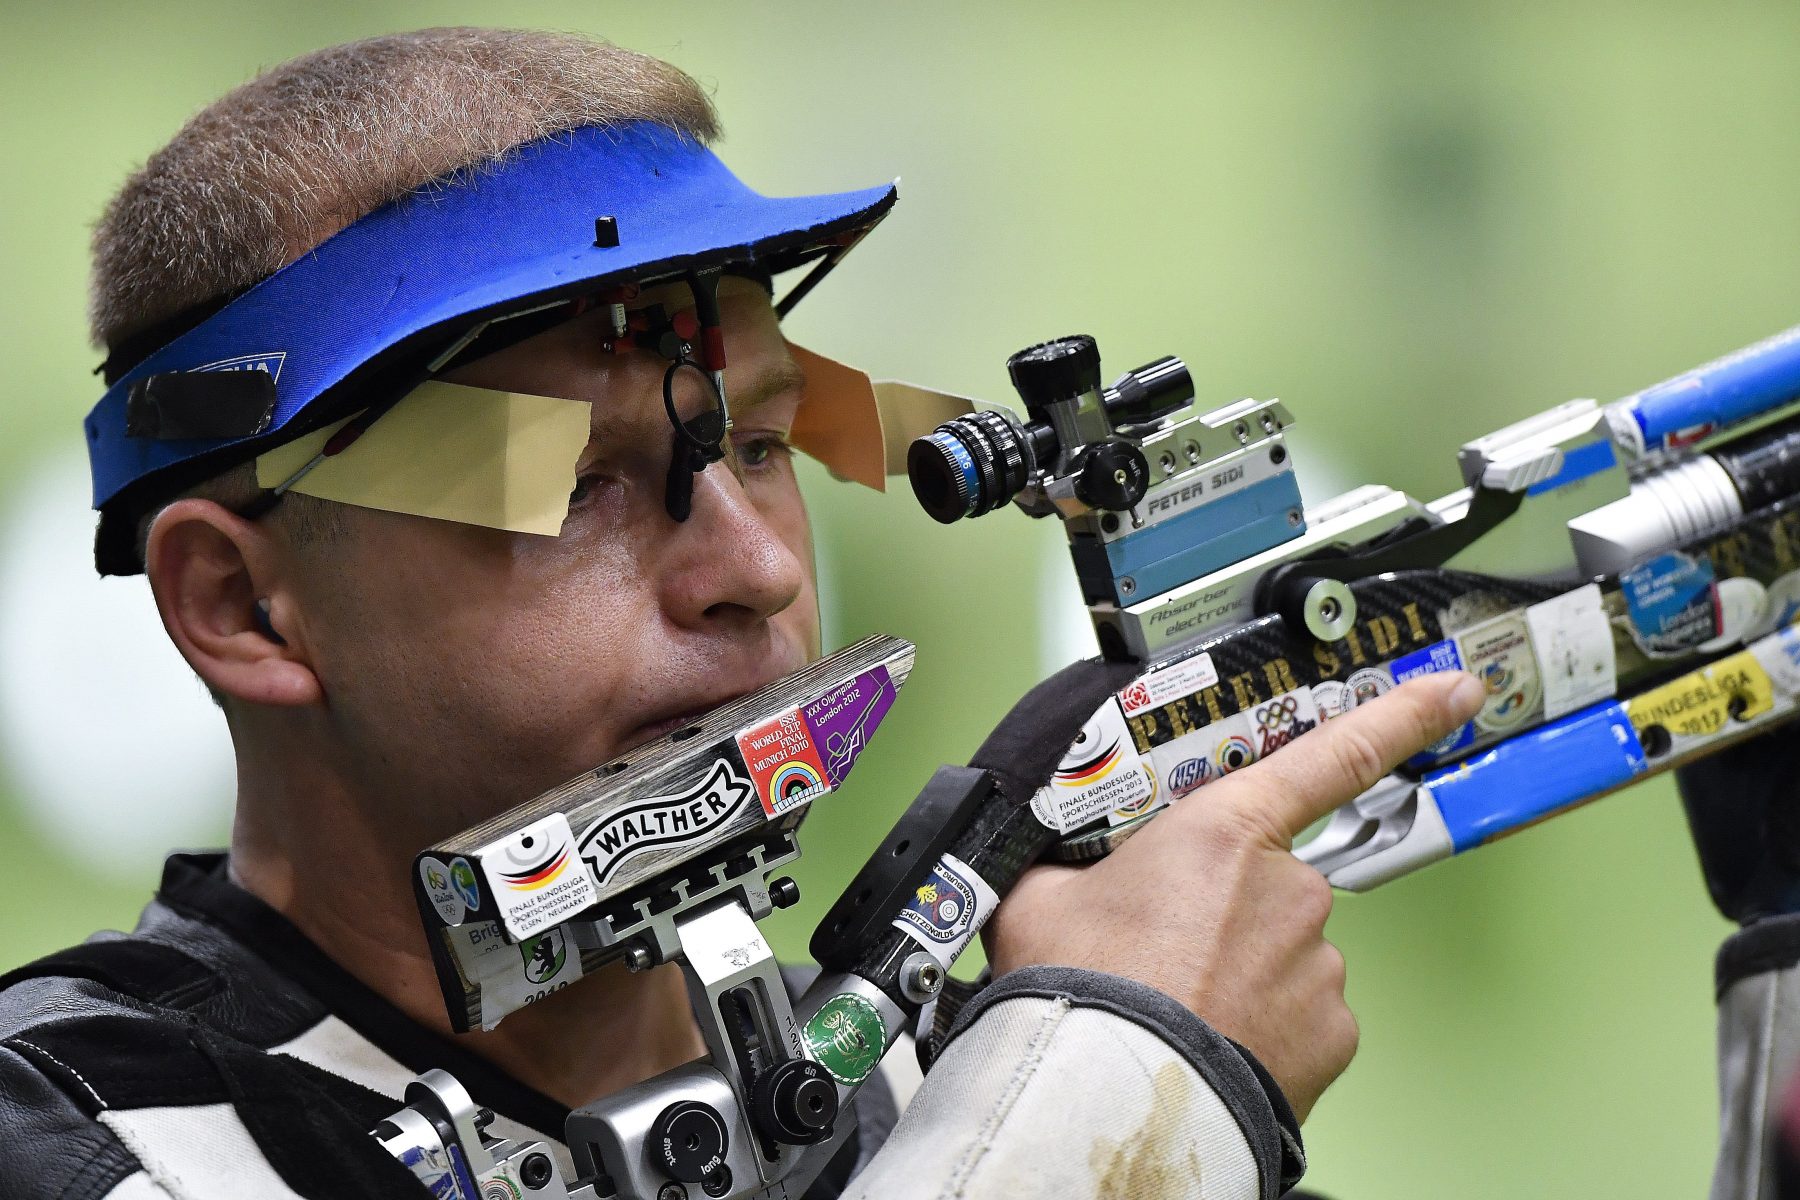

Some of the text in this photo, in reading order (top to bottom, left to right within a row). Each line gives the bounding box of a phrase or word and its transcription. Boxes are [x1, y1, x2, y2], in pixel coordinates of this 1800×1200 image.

[1148, 481, 1203, 515] PETER
[1150, 584, 1234, 625] Absorber
[1128, 657, 1298, 754] PETER
[1313, 602, 1428, 680] SIDI
[806, 678, 857, 718] XXX Olympiad
[815, 689, 860, 727] London 2012
[751, 720, 802, 751] WORLD CUP
[778, 711, 798, 728] ISSF
[753, 739, 809, 773] MUNICH 2010
[780, 731, 806, 748] FINAL
[1059, 769, 1139, 811] FINALE BUNDESLIGA
[1061, 788, 1125, 820] SPORTSCHIESSEN
[1125, 779, 1143, 791] 2013
[596, 791, 727, 855] WALTHER
[1064, 802, 1112, 829] Mengshausen
[1117, 788, 1146, 804] Querum
[509, 876, 585, 916] FINALE BUNDESLIGA
[512, 884, 590, 925] SPORTSCHIESSEN 2012
[520, 918, 542, 932] ELSEN
[547, 896, 587, 918] NEUMARKT
[900, 909, 955, 939] CHÜTZENGILDE
[790, 1033, 797, 1043] 2
[795, 1050, 803, 1060] 3
[663, 1137, 677, 1167] short
[700, 1154, 721, 1176] long
